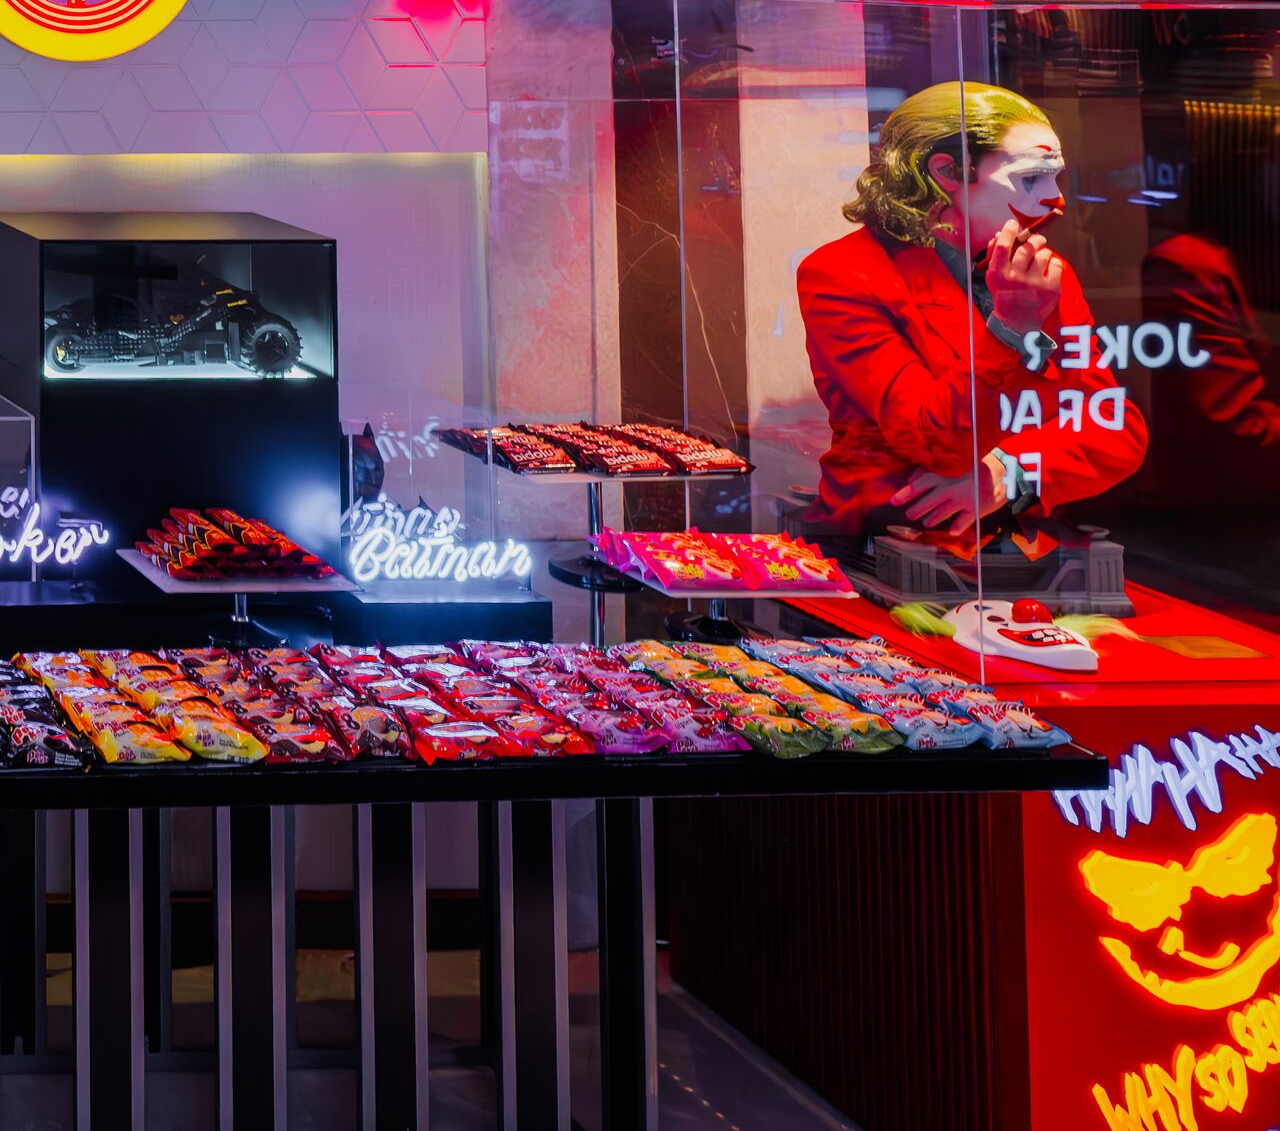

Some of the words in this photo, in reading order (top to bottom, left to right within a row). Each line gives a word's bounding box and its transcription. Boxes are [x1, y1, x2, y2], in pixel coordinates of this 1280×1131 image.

[512, 447, 555, 462] bidolu
[602, 452, 649, 466] bidolu
[676, 449, 724, 463] bidolu
